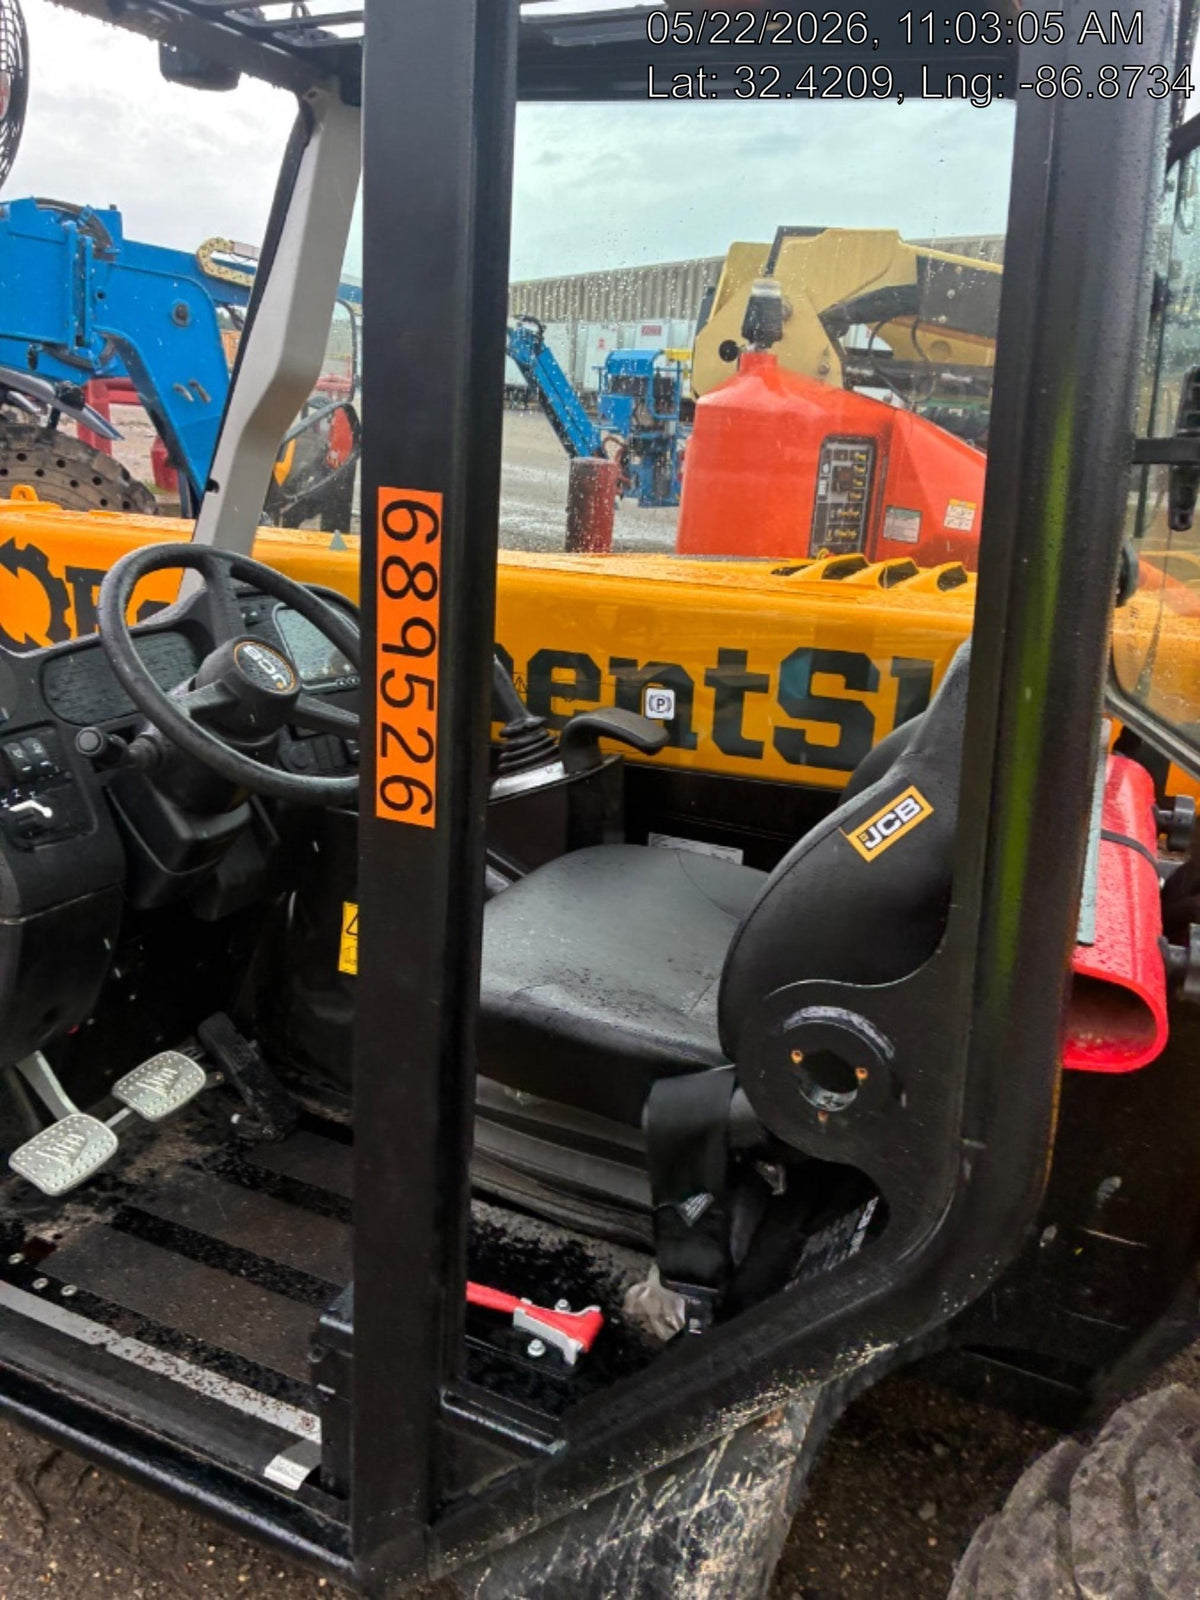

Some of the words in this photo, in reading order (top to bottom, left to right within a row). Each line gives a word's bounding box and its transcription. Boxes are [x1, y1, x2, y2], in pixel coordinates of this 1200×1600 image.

[243, 645, 287, 687] JCB
[380, 499, 440, 815] 689526
[864, 797, 922, 849] JCB
